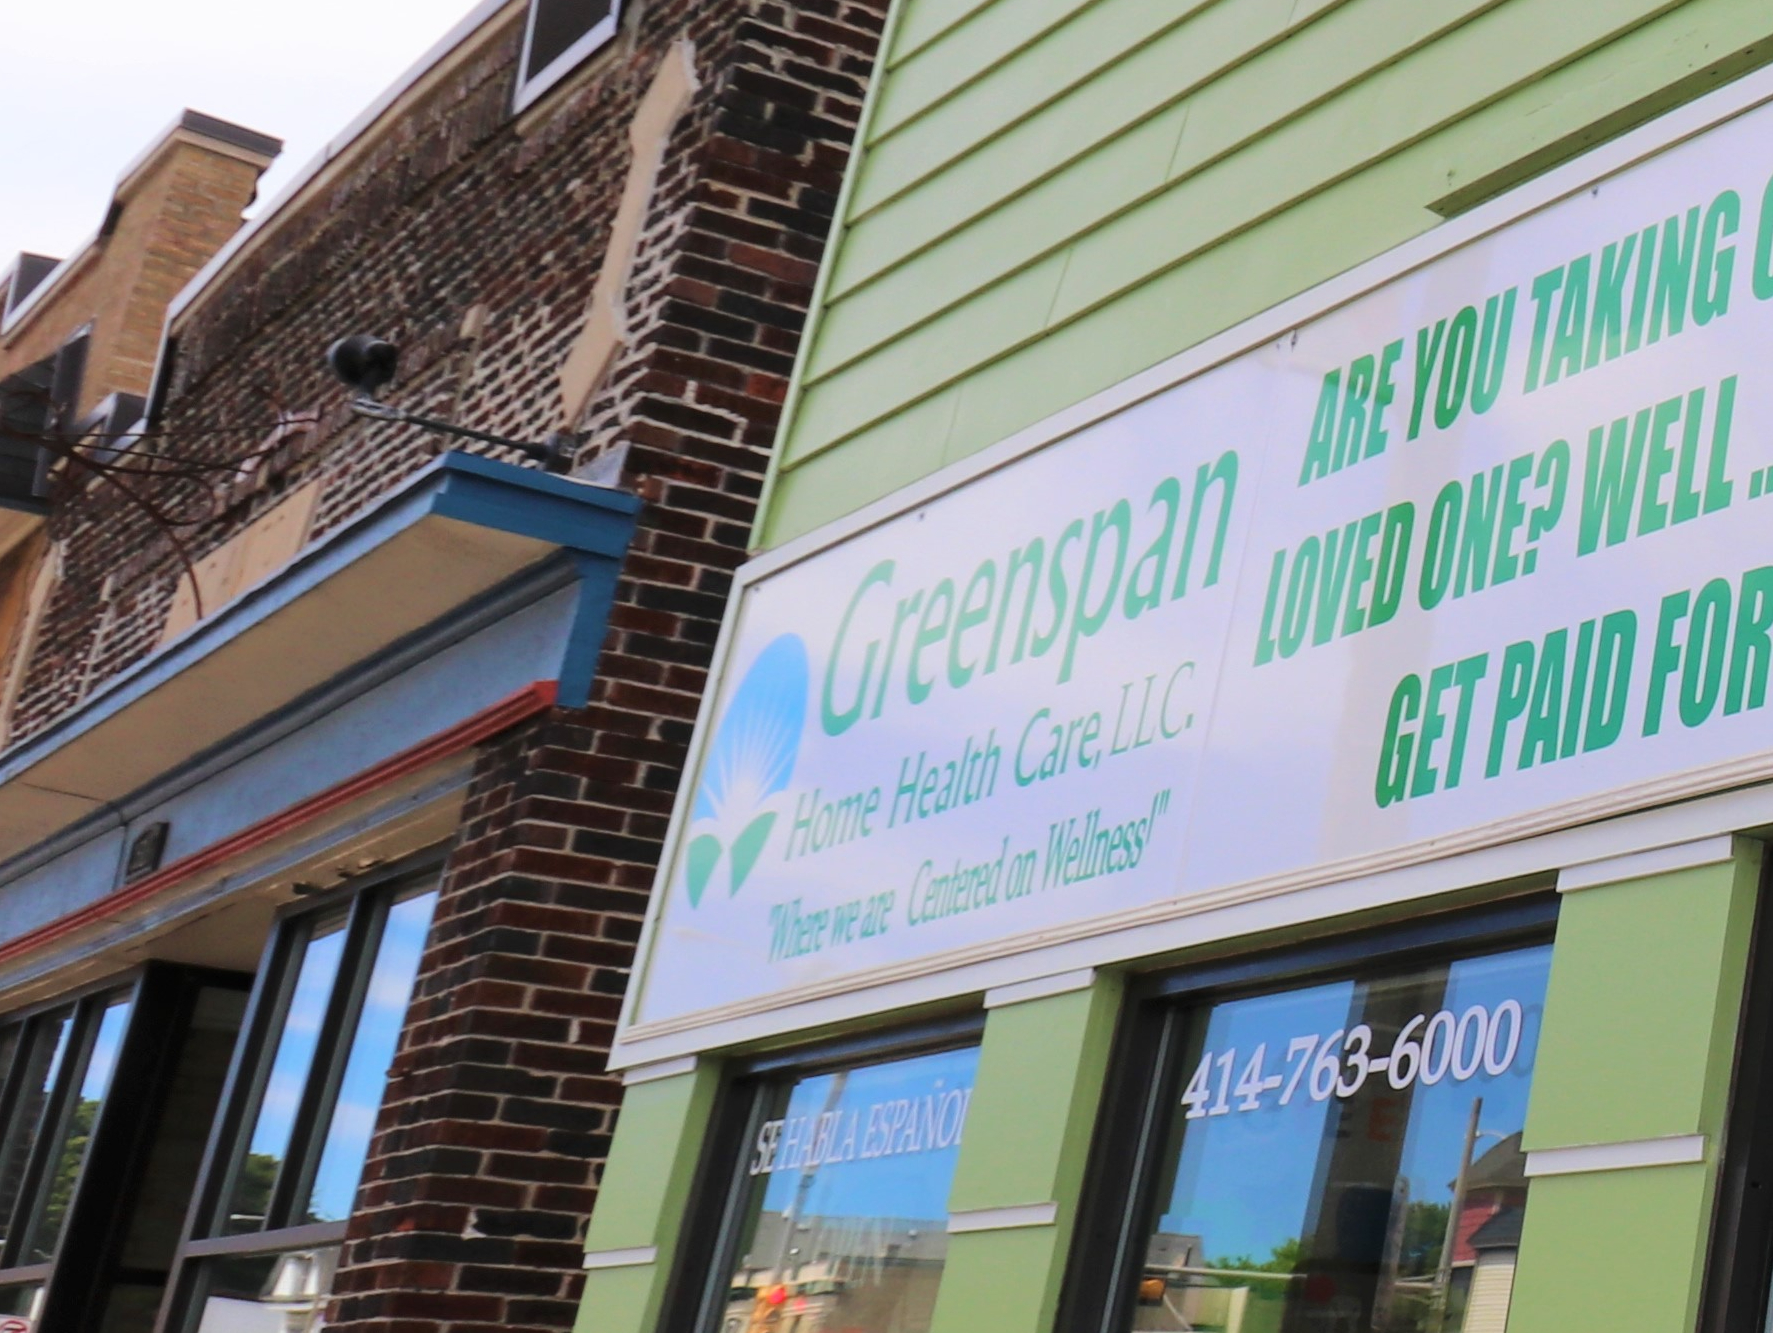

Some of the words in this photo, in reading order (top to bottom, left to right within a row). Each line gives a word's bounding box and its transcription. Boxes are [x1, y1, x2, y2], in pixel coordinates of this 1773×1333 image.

[1298, 337, 1403, 488] ARE
[1405, 285, 1518, 442] YOU
[1521, 189, 1742, 396] TAKING
[820, 450, 1239, 736] Greenspan
[1253, 500, 1415, 668] LOVED
[1417, 438, 1571, 611] ONE?
[785, 785, 881, 861] Home
[887, 728, 1001, 829] Health
[1109, 661, 1195, 756] LLC.
[1374, 650, 1490, 810] GET
[1484, 608, 1637, 778] PAID
[830, 903, 861, 945] we
[860, 889, 896, 938] are
[907, 836, 1009, 927] Centered
[1005, 847, 1038, 902] on
[749, 1119, 786, 1176] SE
[777, 1109, 860, 1171] HABLA
[1180, 999, 1523, 1120] 414-763-6000
